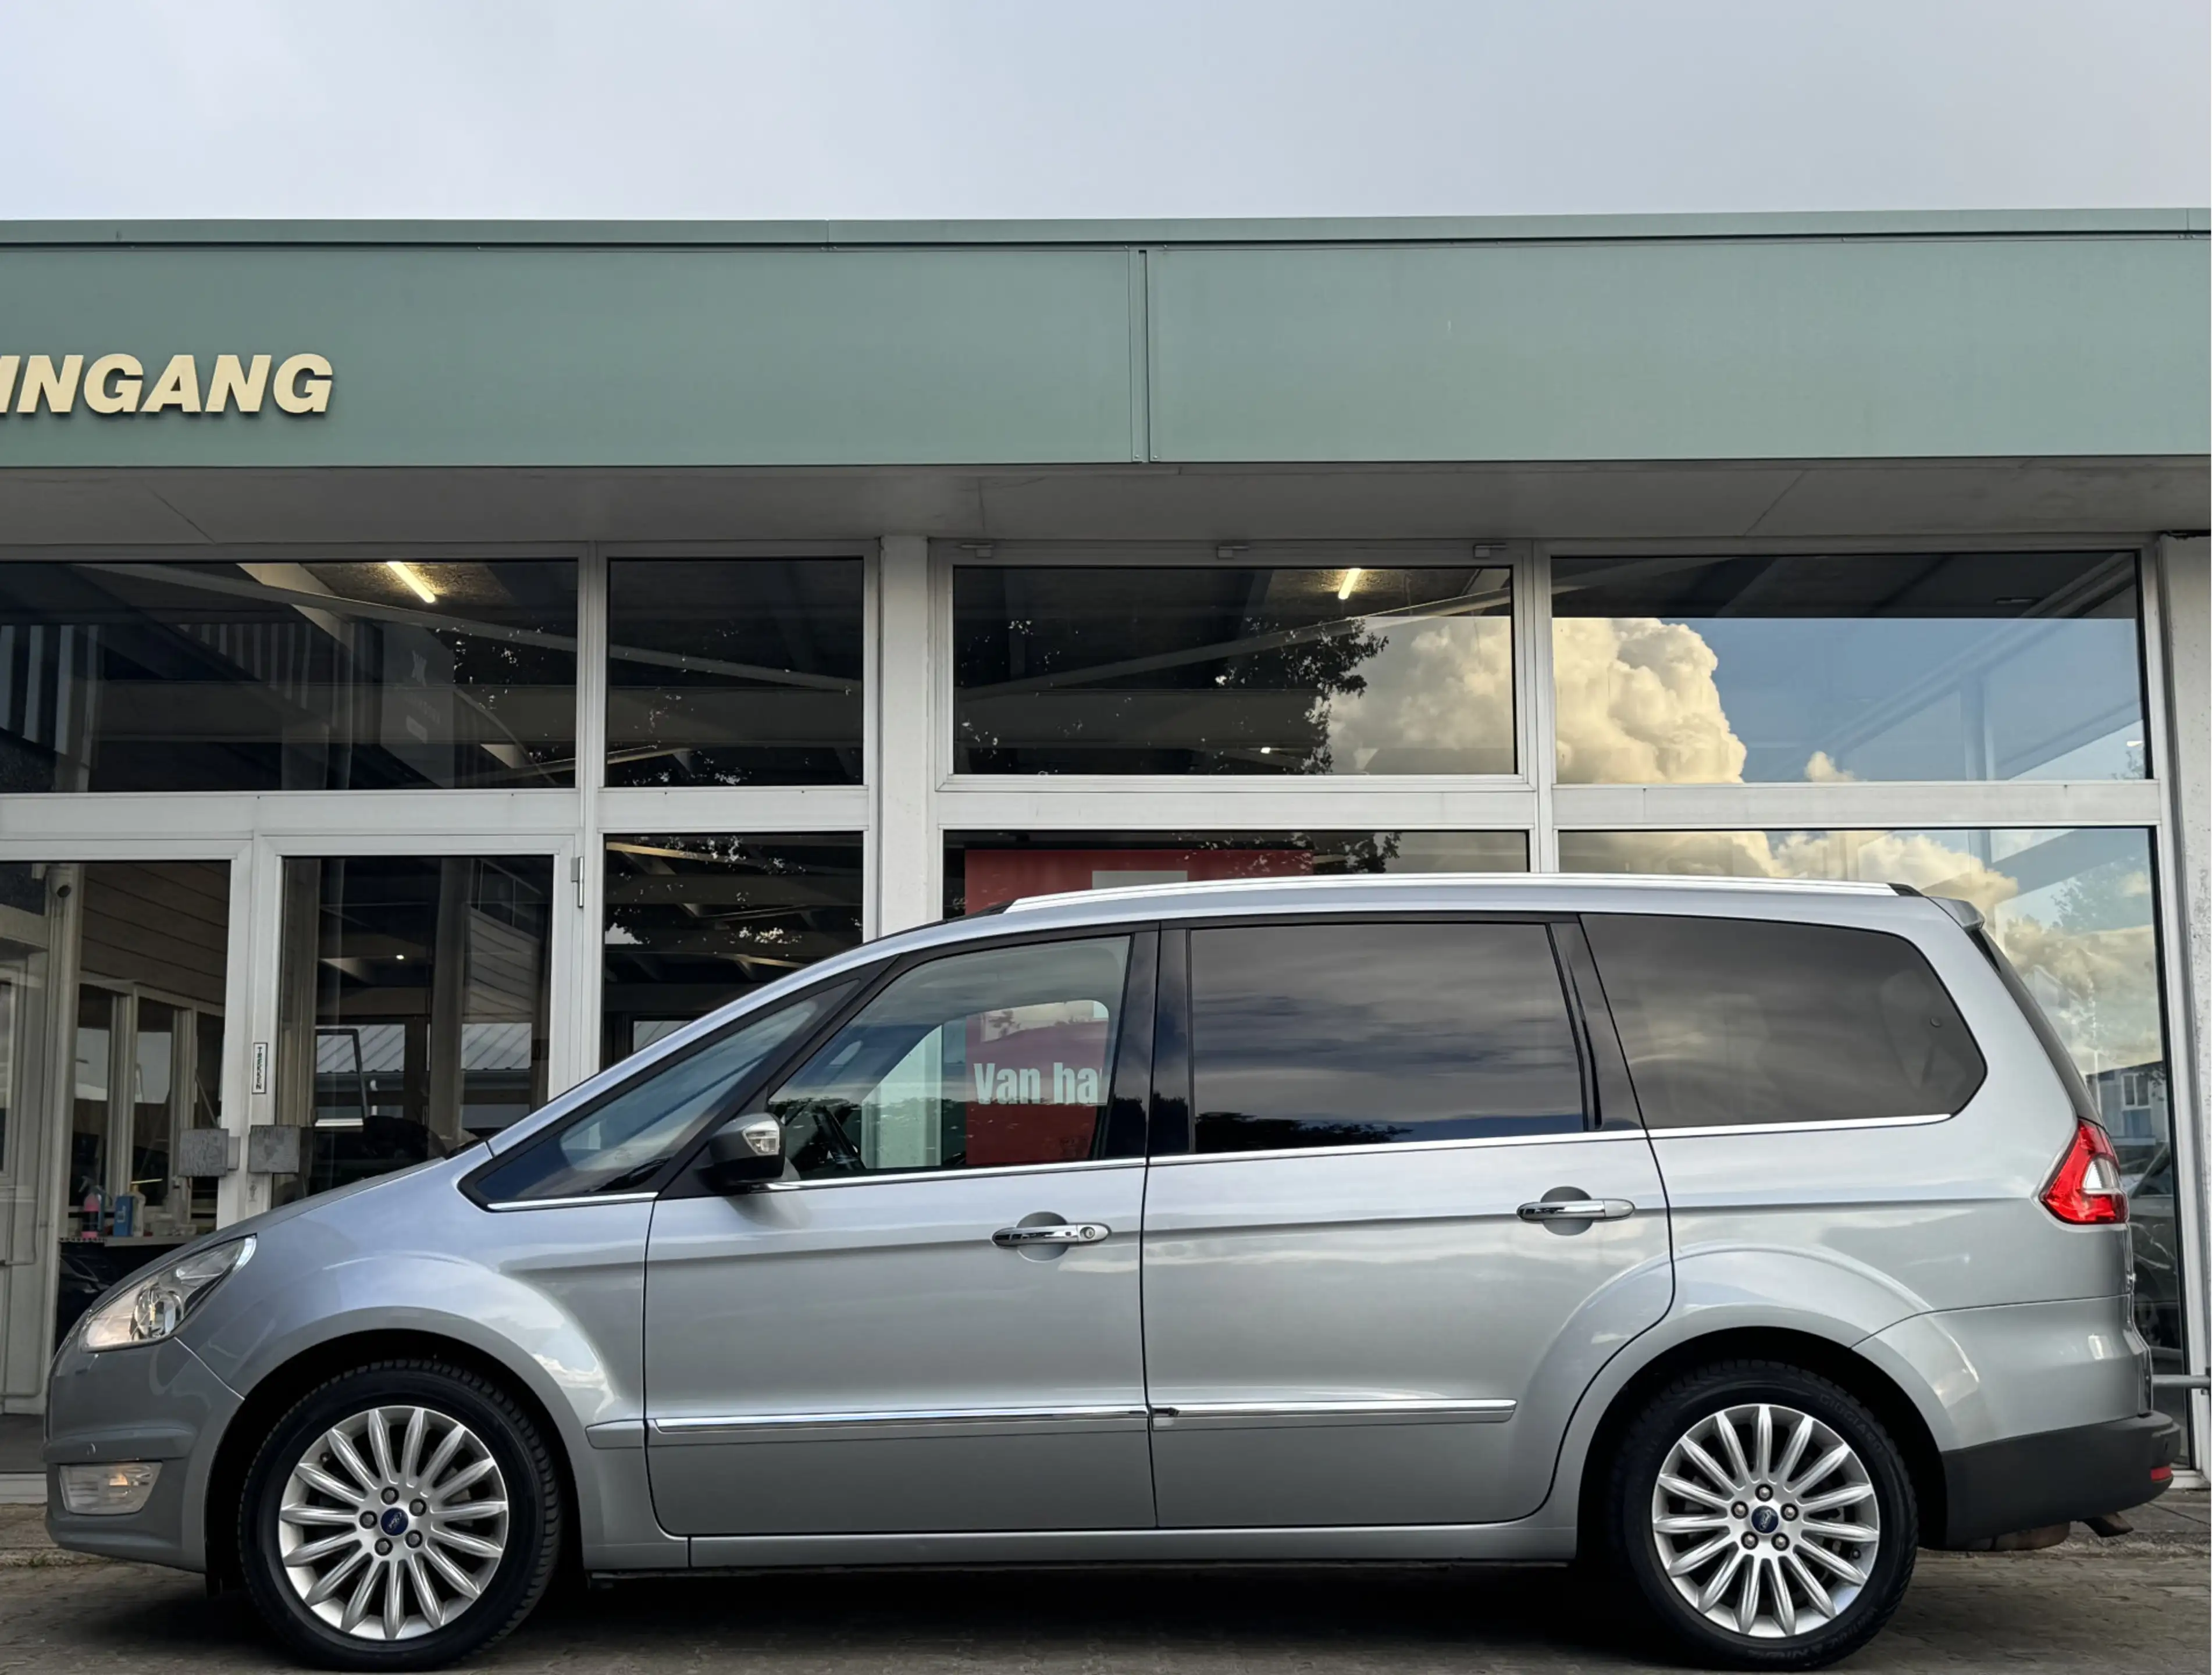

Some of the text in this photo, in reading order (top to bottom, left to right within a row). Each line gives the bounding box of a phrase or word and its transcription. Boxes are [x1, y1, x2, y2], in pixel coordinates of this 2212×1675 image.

[0, 353, 333, 414] INGANG
[973, 1062, 1102, 1104] Van ha
